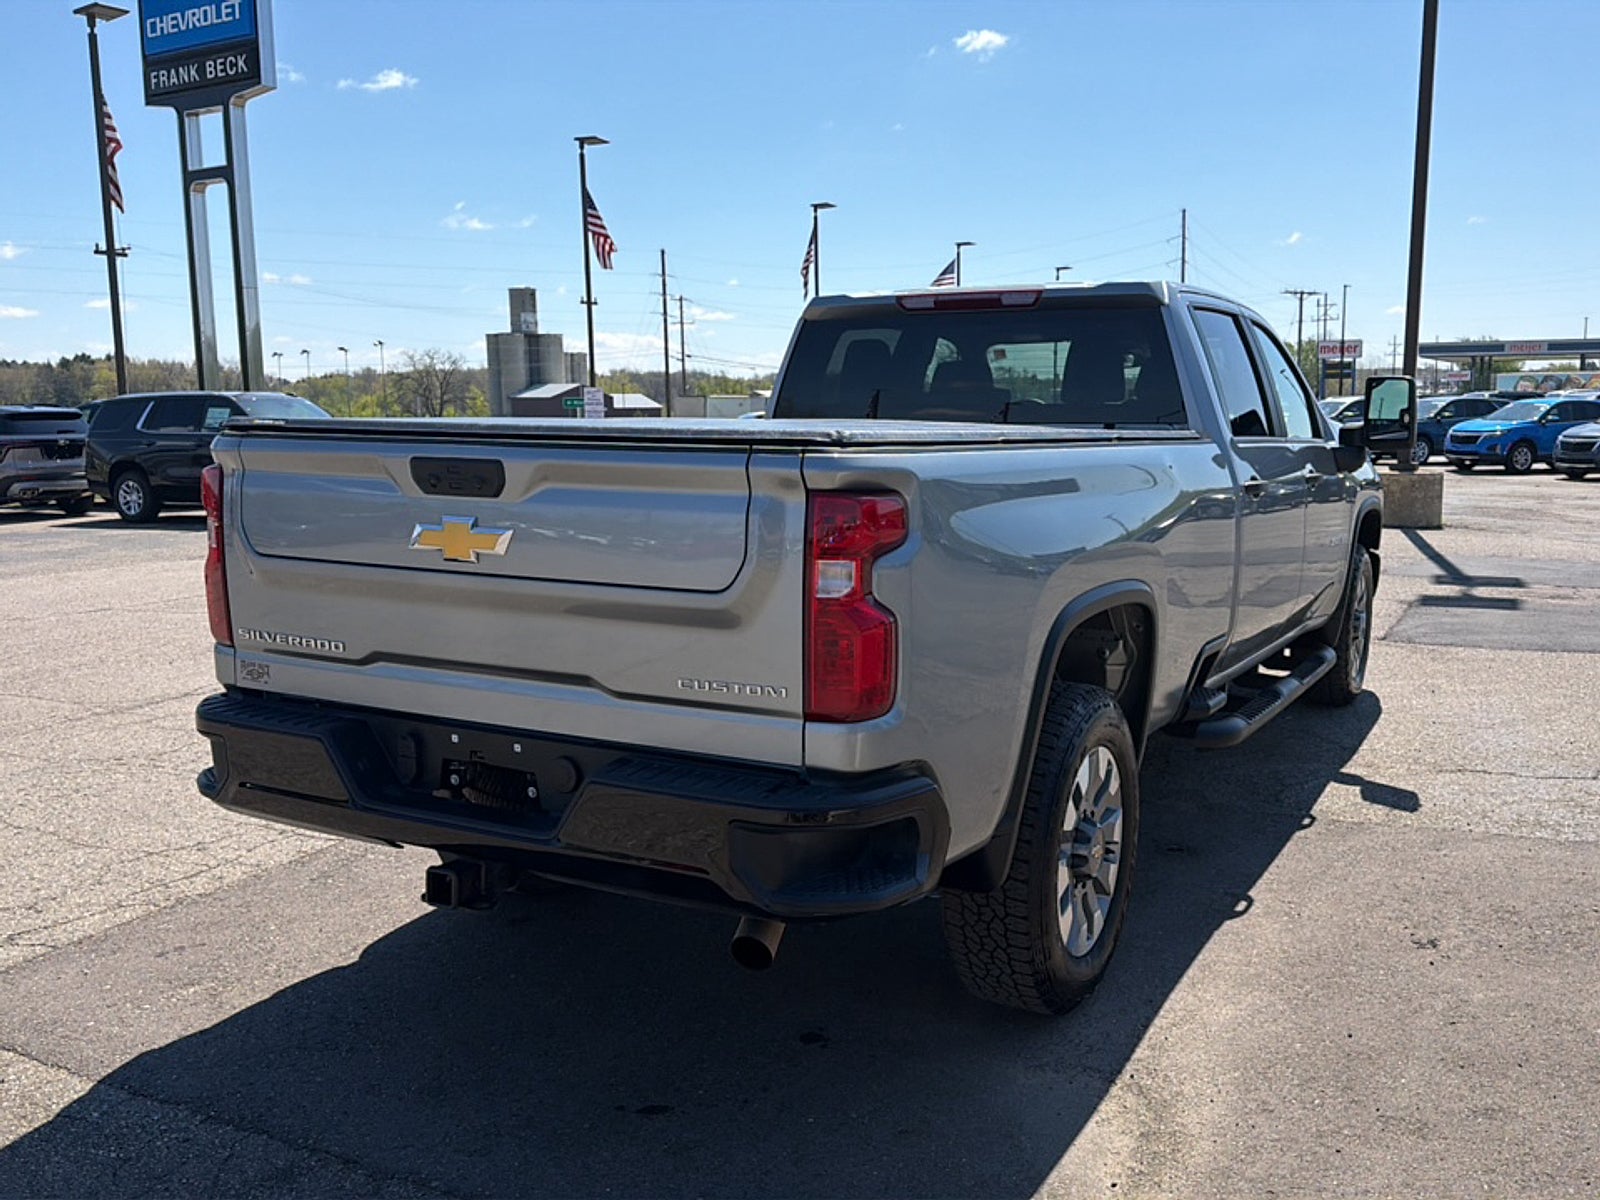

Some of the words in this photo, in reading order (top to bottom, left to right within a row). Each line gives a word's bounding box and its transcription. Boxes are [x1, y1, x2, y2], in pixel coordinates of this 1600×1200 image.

[146, 1, 241, 38] CHEVROLET
[150, 63, 200, 90] FRANK
[205, 53, 248, 80] BECK
[238, 627, 346, 653] SILVERADO
[678, 678, 788, 698] CUSTOM
